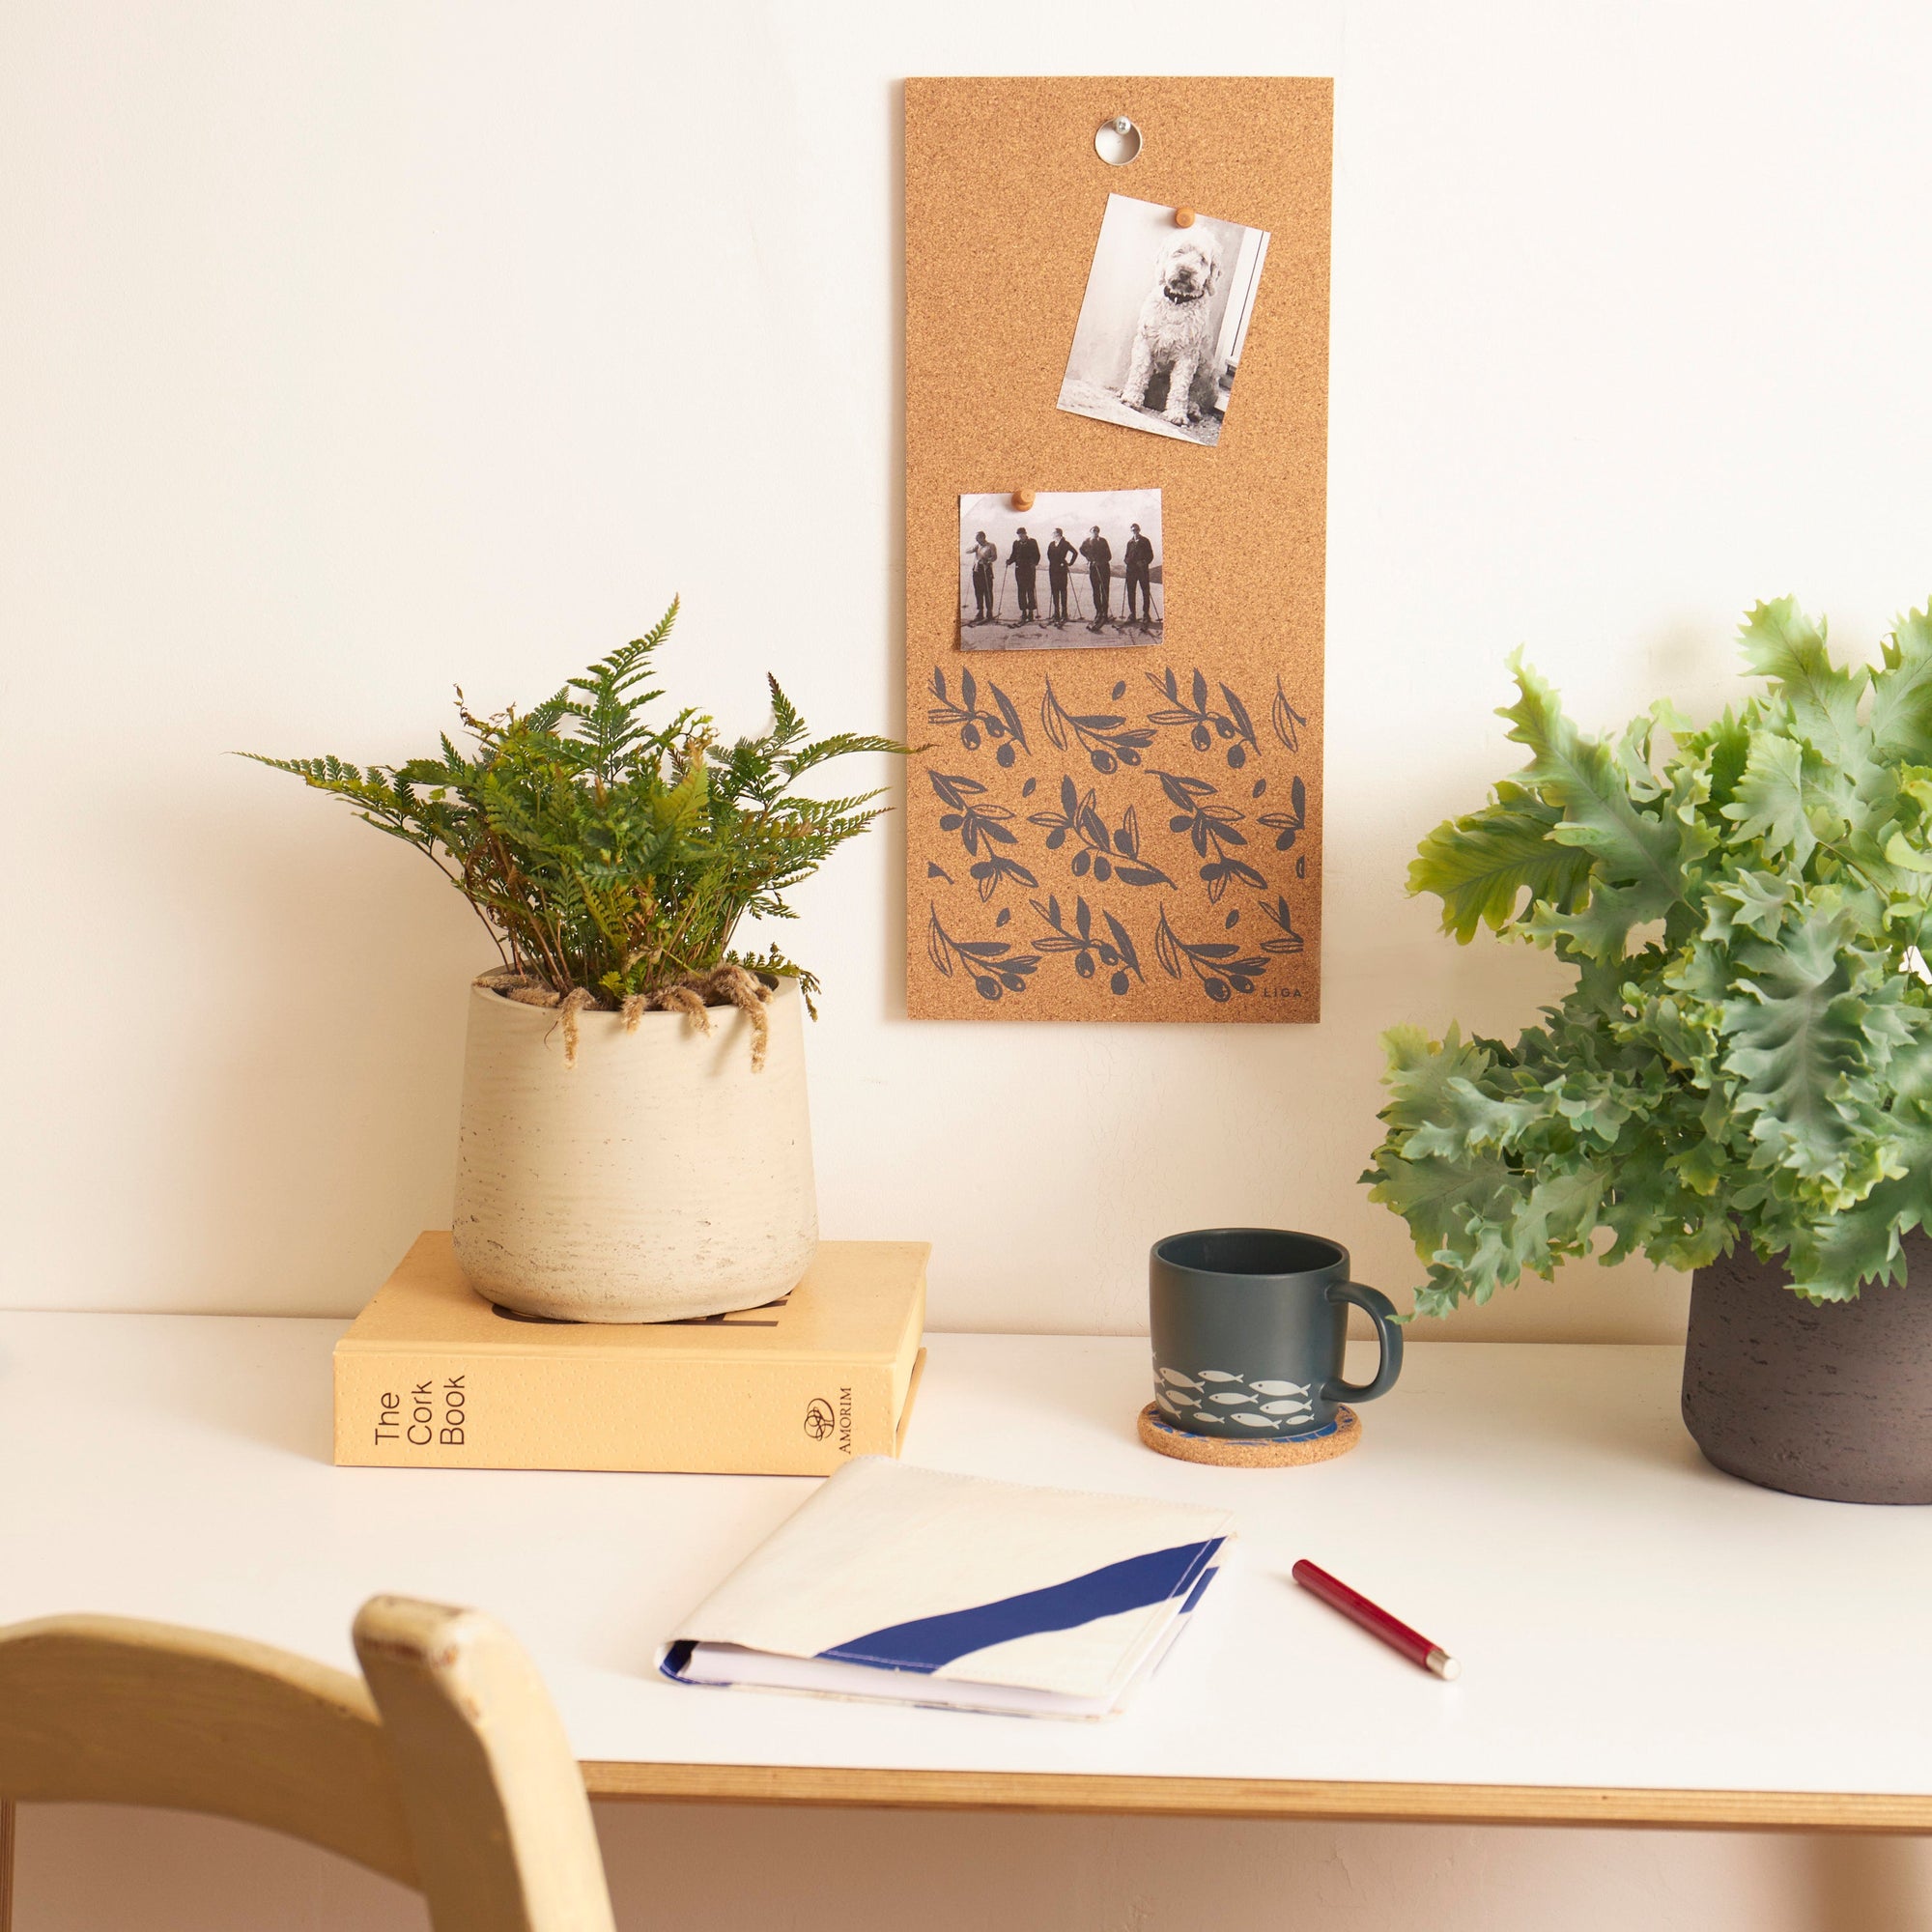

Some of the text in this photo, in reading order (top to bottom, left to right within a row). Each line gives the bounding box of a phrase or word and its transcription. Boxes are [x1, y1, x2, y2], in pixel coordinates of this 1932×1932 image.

[1264, 987, 1302, 998] LIGA
[375, 1392, 400, 1445] The
[407, 1380, 433, 1445] Cork
[440, 1375, 466, 1445] Book
[838, 1387, 851, 1455] AMORIM
